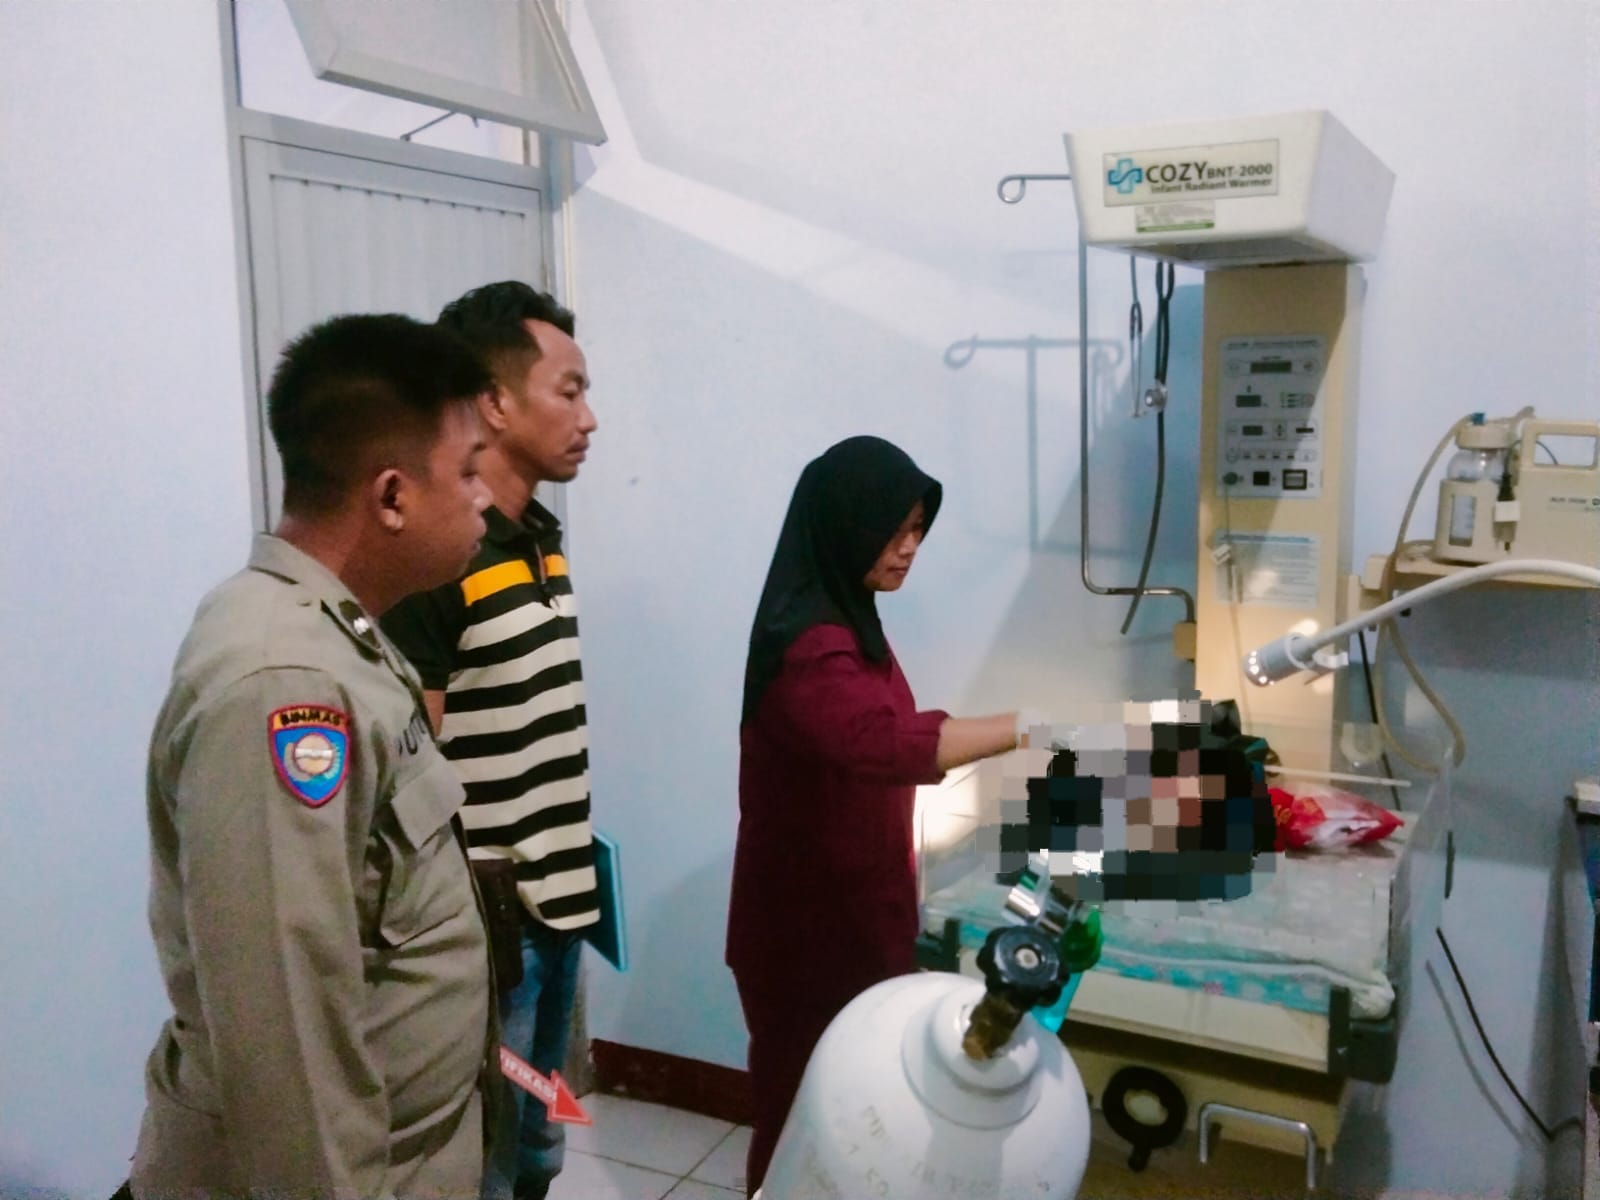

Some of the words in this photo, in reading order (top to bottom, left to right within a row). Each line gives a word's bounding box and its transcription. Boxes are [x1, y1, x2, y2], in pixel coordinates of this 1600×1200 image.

[1146, 161, 1208, 183] COZY
[1151, 183, 1182, 193] Infant
[1185, 180, 1226, 192] Radiant
[1229, 178, 1272, 188] Warmer
[280, 709, 339, 726] BINMAS
